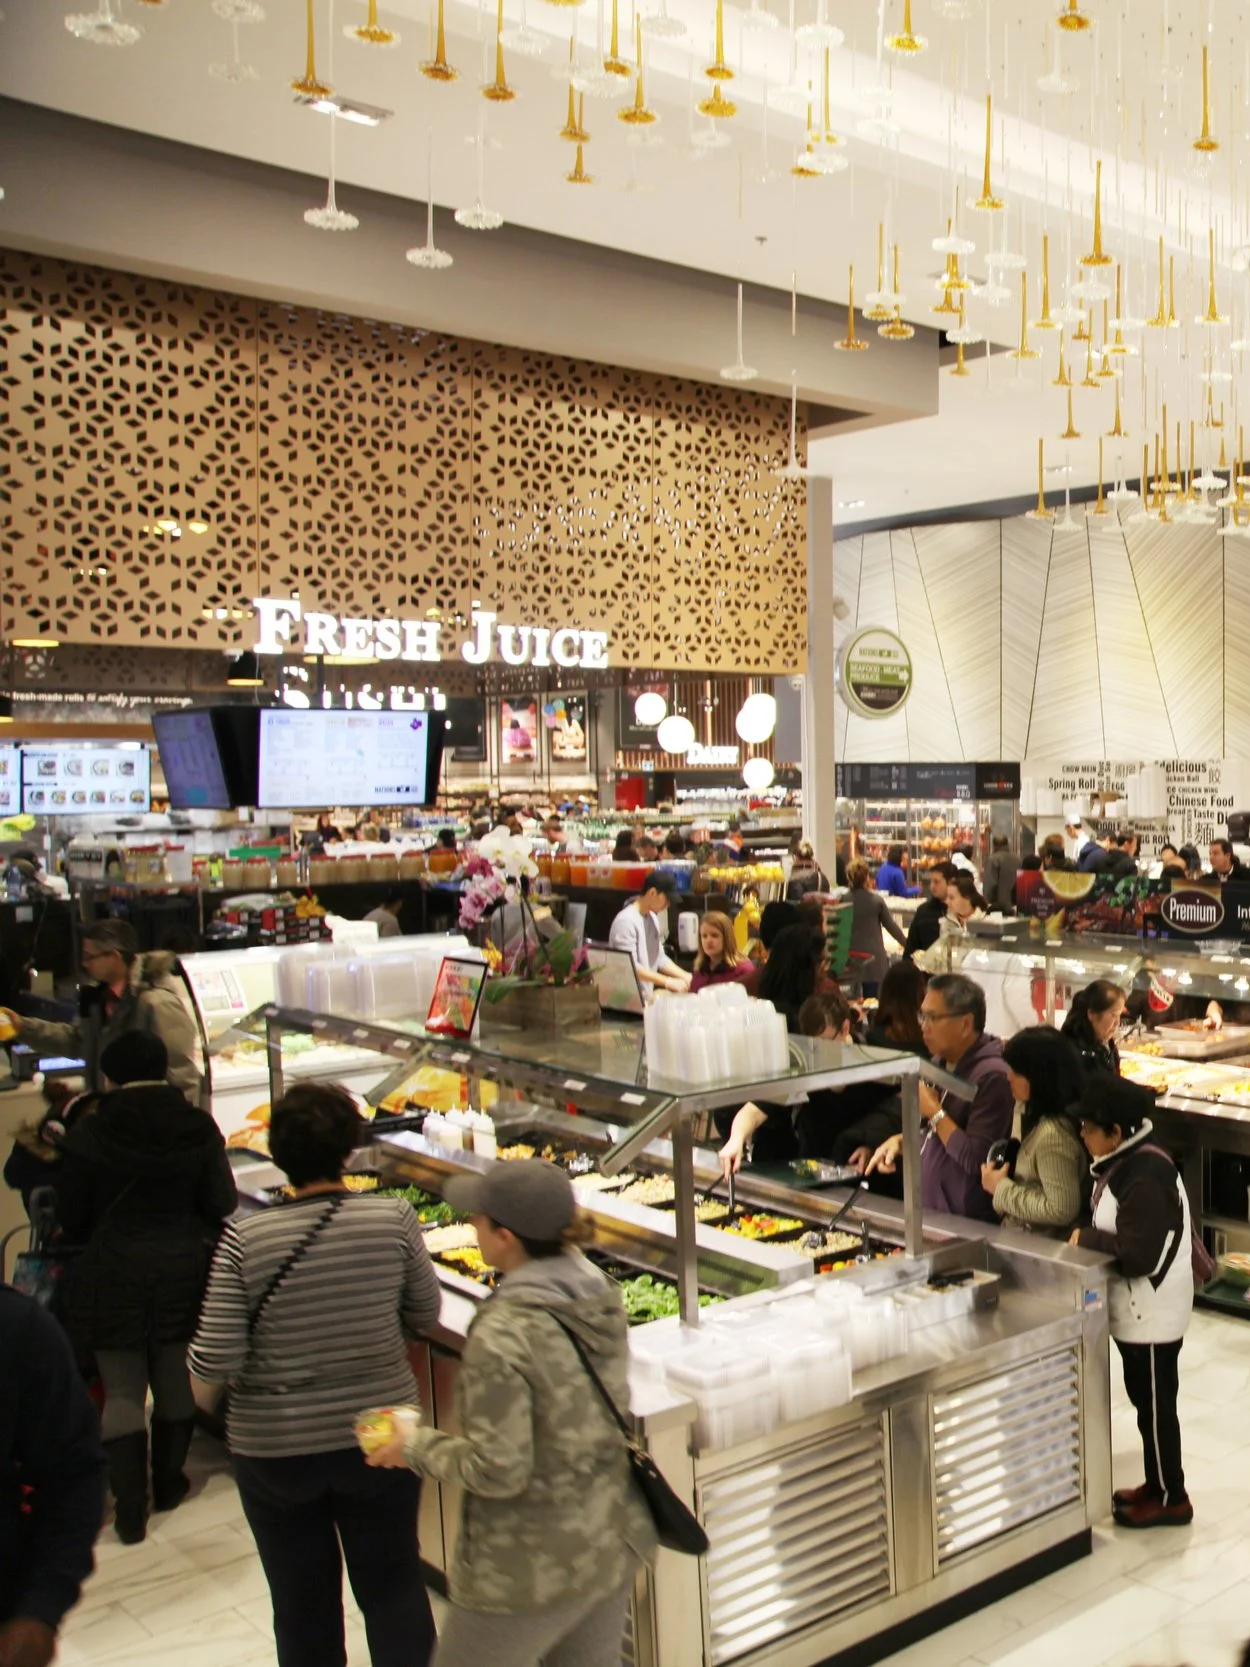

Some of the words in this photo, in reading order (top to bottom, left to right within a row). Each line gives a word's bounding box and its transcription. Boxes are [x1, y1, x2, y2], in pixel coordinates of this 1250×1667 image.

[252, 598, 441, 662] FRESH
[461, 610, 609, 669] JUICE
[1048, 778, 1076, 791] Spring
[1078, 778, 1096, 790] Roll
[1168, 794, 1207, 807] Chinese
[1210, 795, 1234, 807] Food
[1169, 897, 1217, 923] Premium
